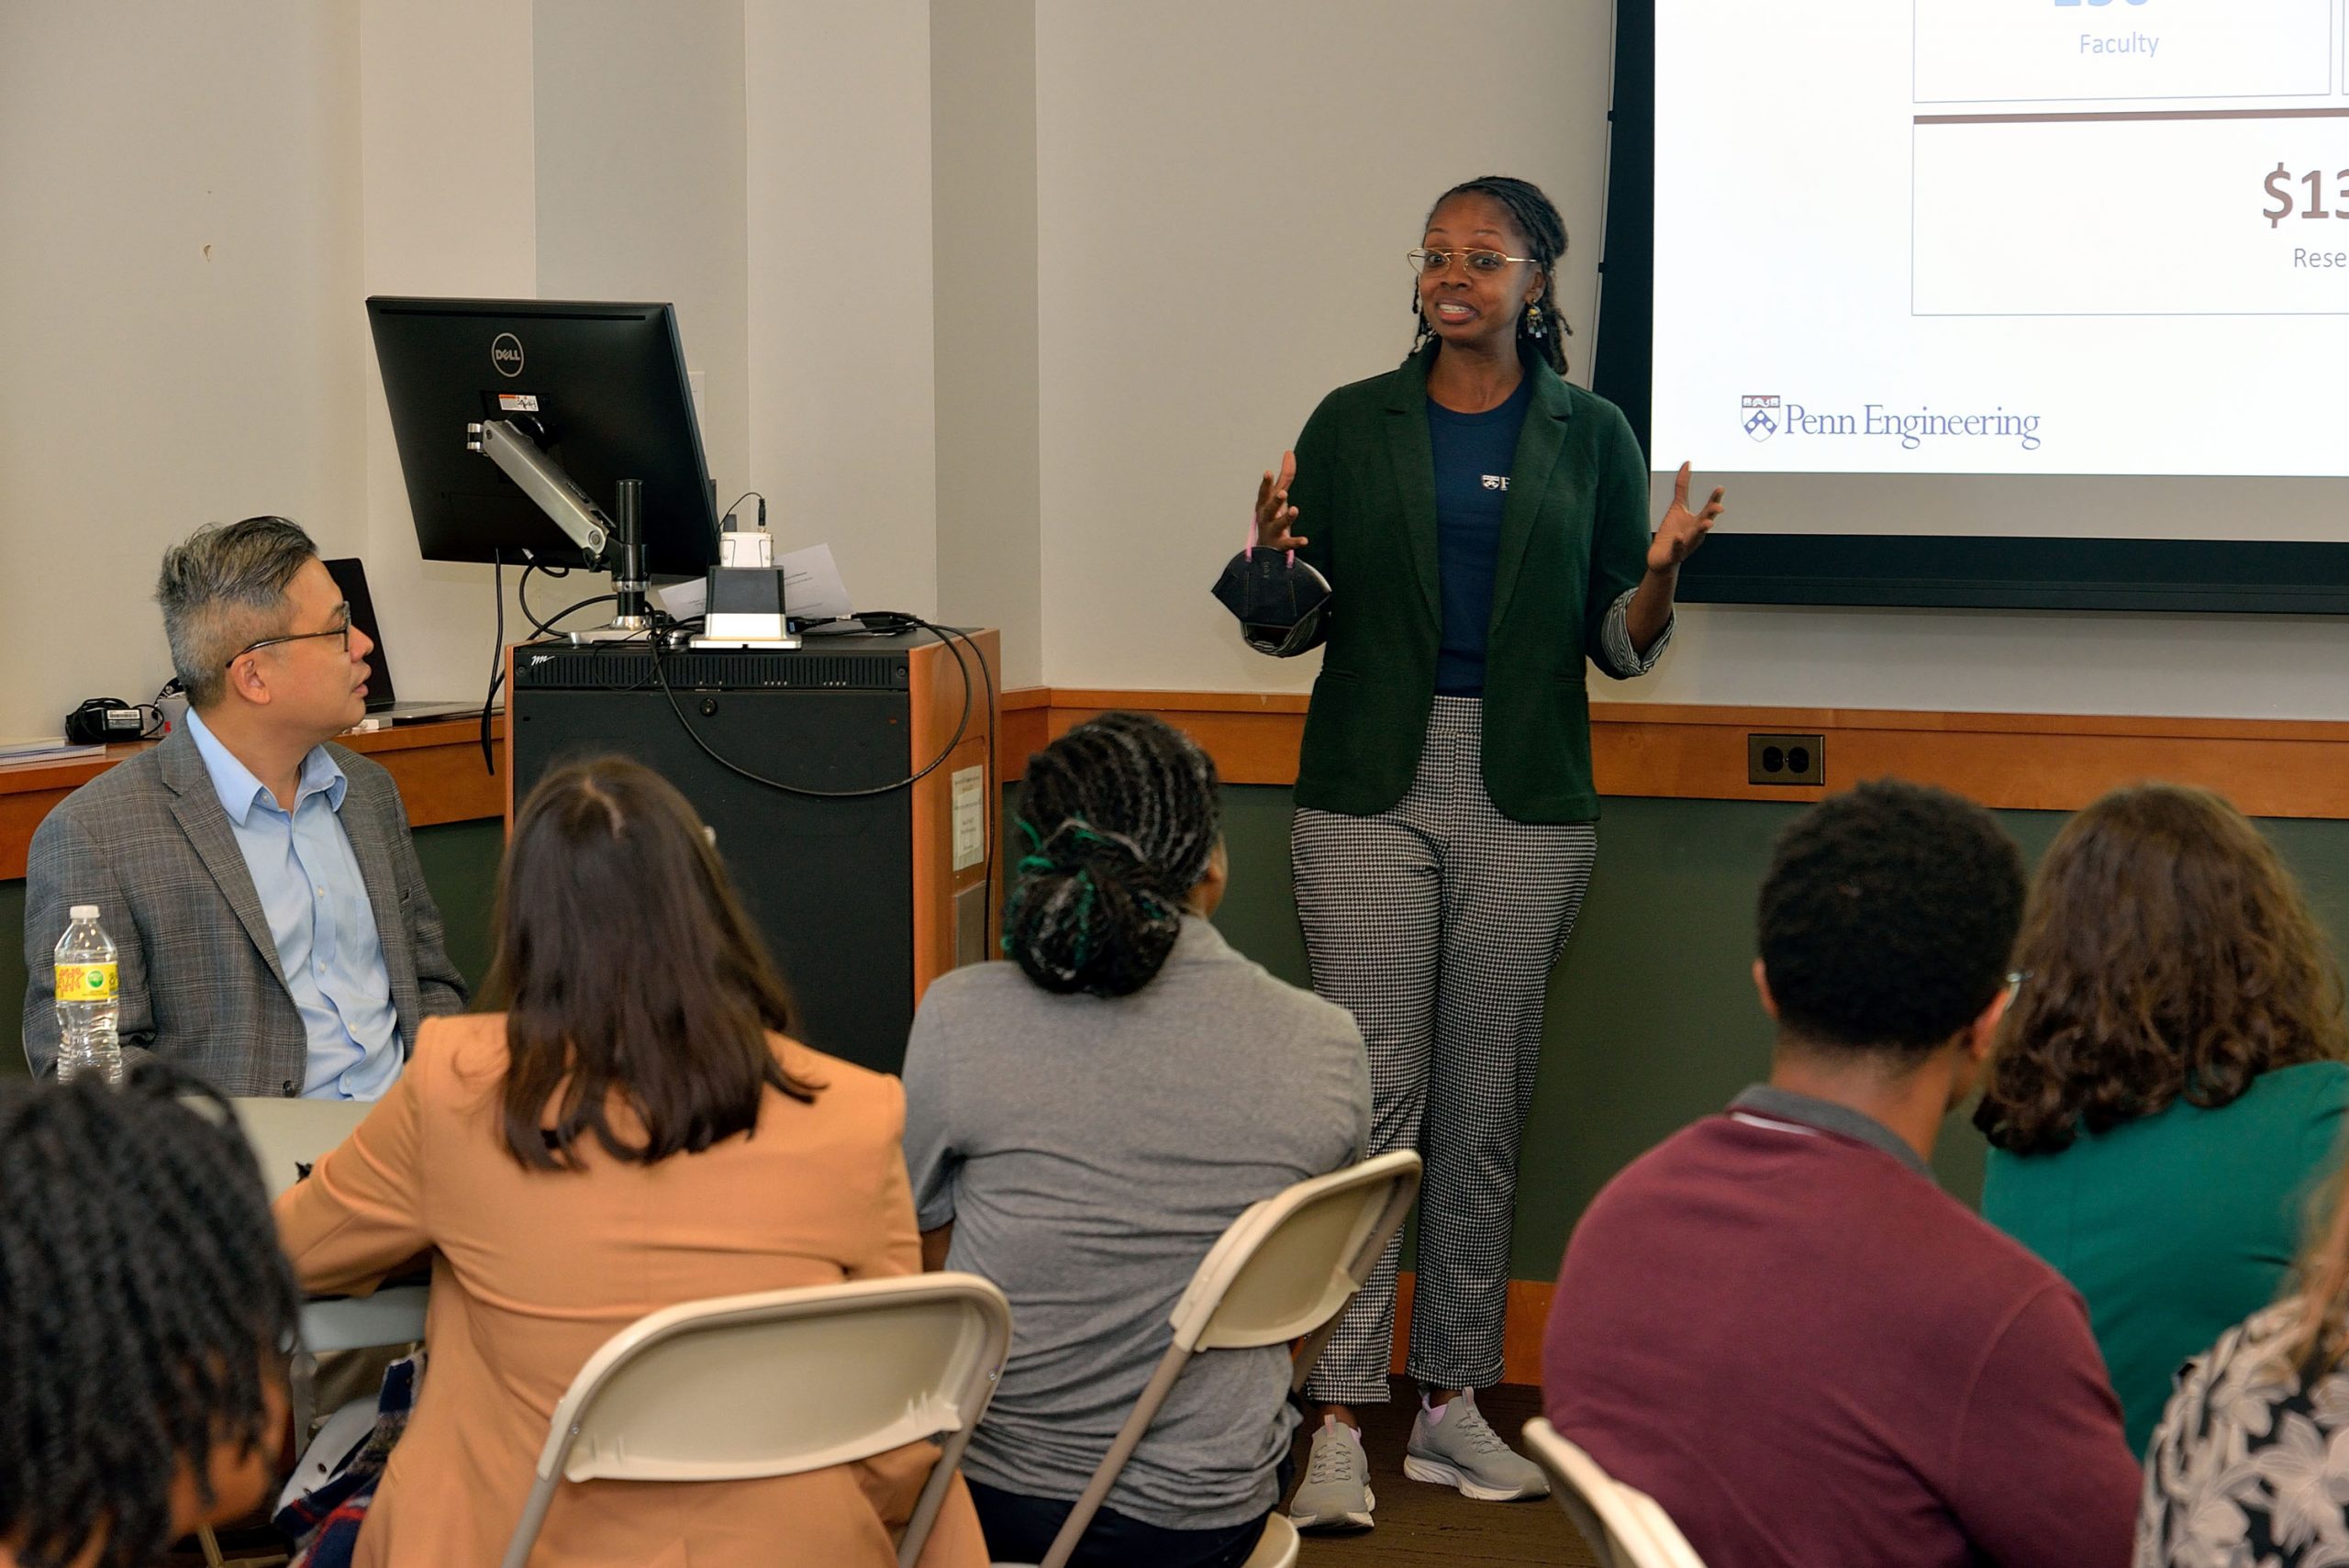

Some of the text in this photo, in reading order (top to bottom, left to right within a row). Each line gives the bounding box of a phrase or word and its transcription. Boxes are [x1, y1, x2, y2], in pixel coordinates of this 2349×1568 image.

[2080, 31, 2159, 58] Faculty
[2294, 248, 2347, 268] Rese
[495, 349, 520, 361] DELL
[1785, 404, 2042, 450] Penn Engineering
